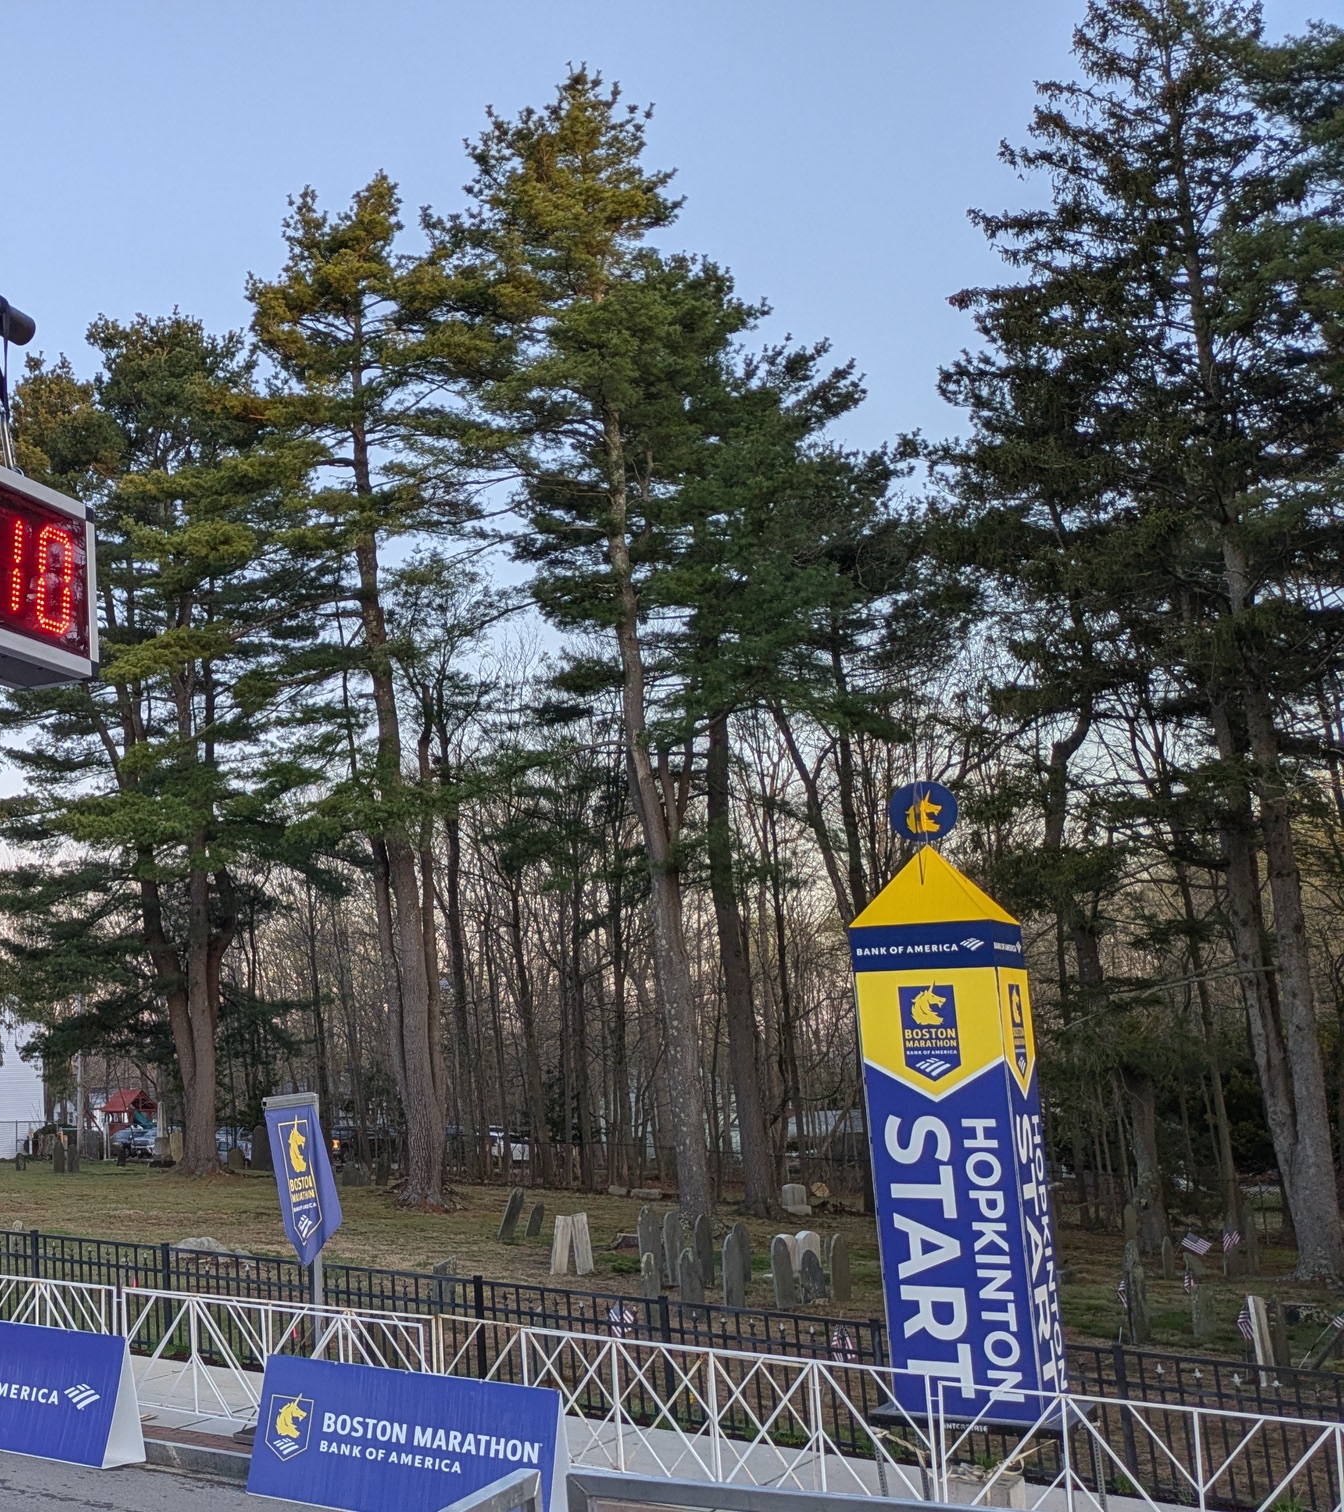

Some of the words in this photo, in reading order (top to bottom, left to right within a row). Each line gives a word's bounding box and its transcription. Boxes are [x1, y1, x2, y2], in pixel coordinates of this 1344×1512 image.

[856, 948, 887, 956] BANK
[890, 946, 904, 954] OF
[906, 944, 958, 954] AMERICA
[904, 1028, 956, 1039] BOSTON
[906, 1039, 957, 1047] MARATHON
[884, 1114, 976, 1399] START
[961, 1118, 1025, 1403] HOPKINTON
[1016, 1114, 1059, 1394] START
[1031, 1115, 1068, 1391] HOPKINTON
[319, 1440, 361, 1458] BANK
[365, 1448, 386, 1461] OF
[388, 1451, 461, 1474] AMERICA
[322, 1412, 407, 1444] BOSTON
[413, 1425, 540, 1464] MARATHON
